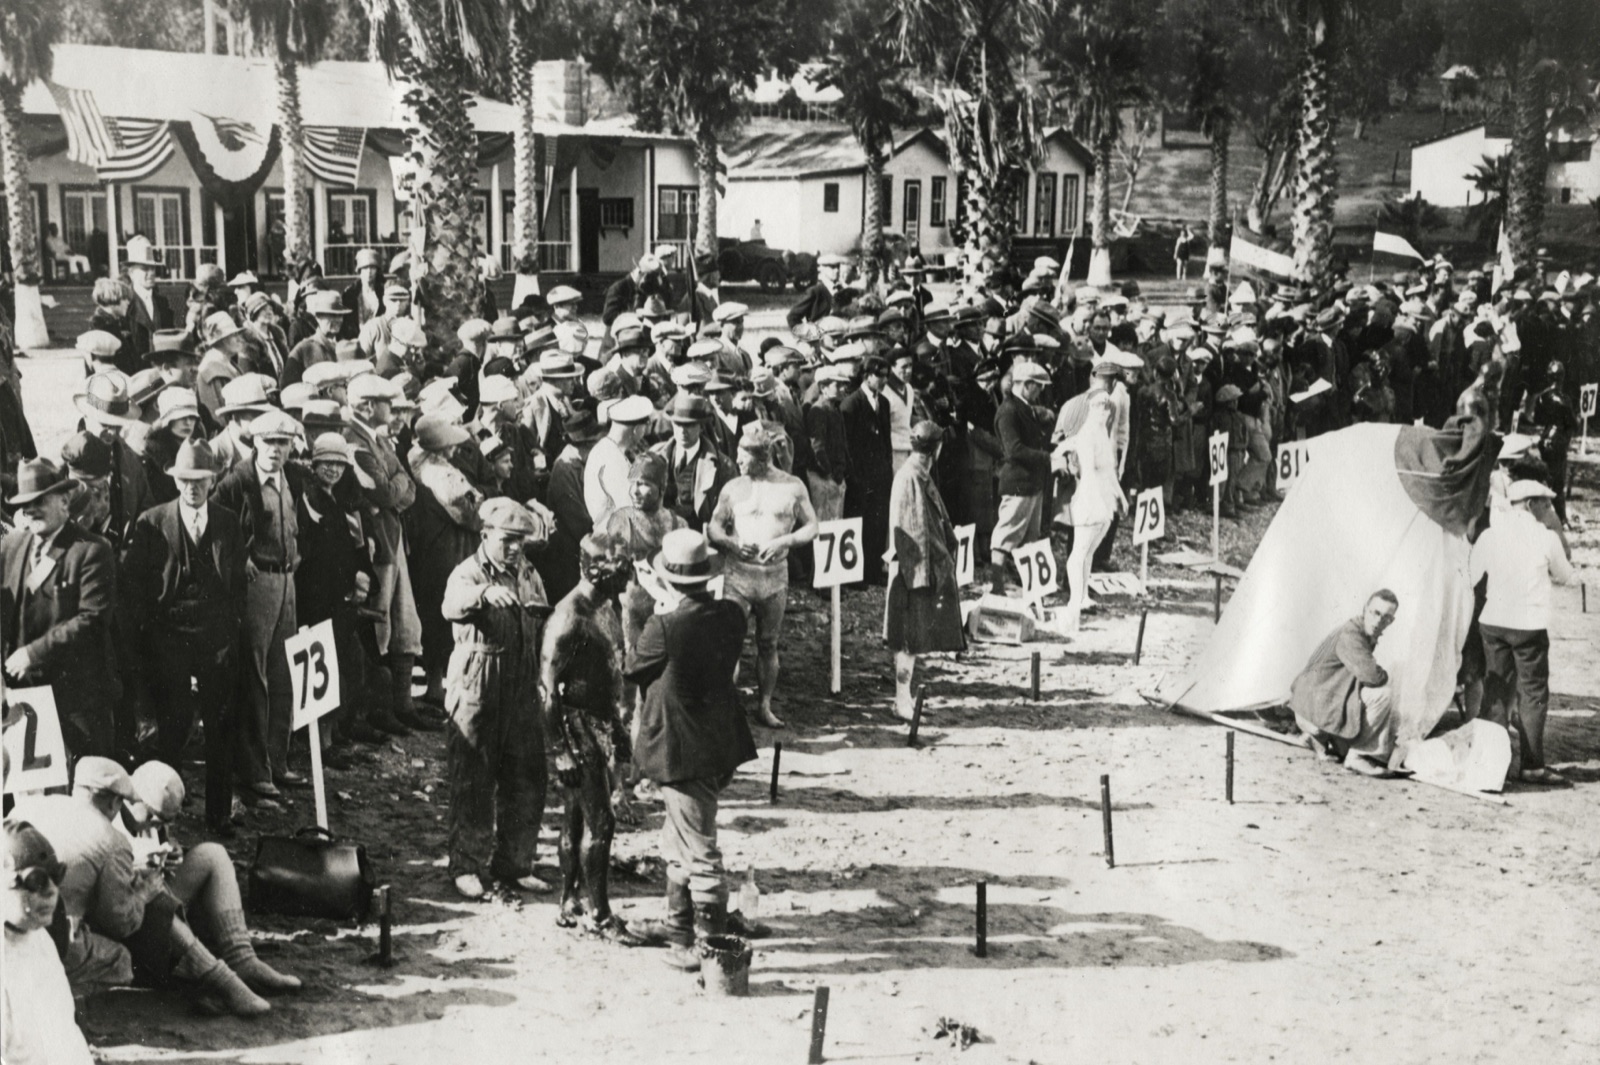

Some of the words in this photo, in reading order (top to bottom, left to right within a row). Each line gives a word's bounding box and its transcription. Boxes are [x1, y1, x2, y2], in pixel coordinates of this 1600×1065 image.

[1582, 390, 1596, 413] 87
[1212, 441, 1225, 476] 80
[1280, 448, 1300, 480] 81
[1138, 497, 1161, 534] 79
[818, 529, 858, 574] 76
[1020, 551, 1051, 591] 78
[293, 641, 329, 710] 73
